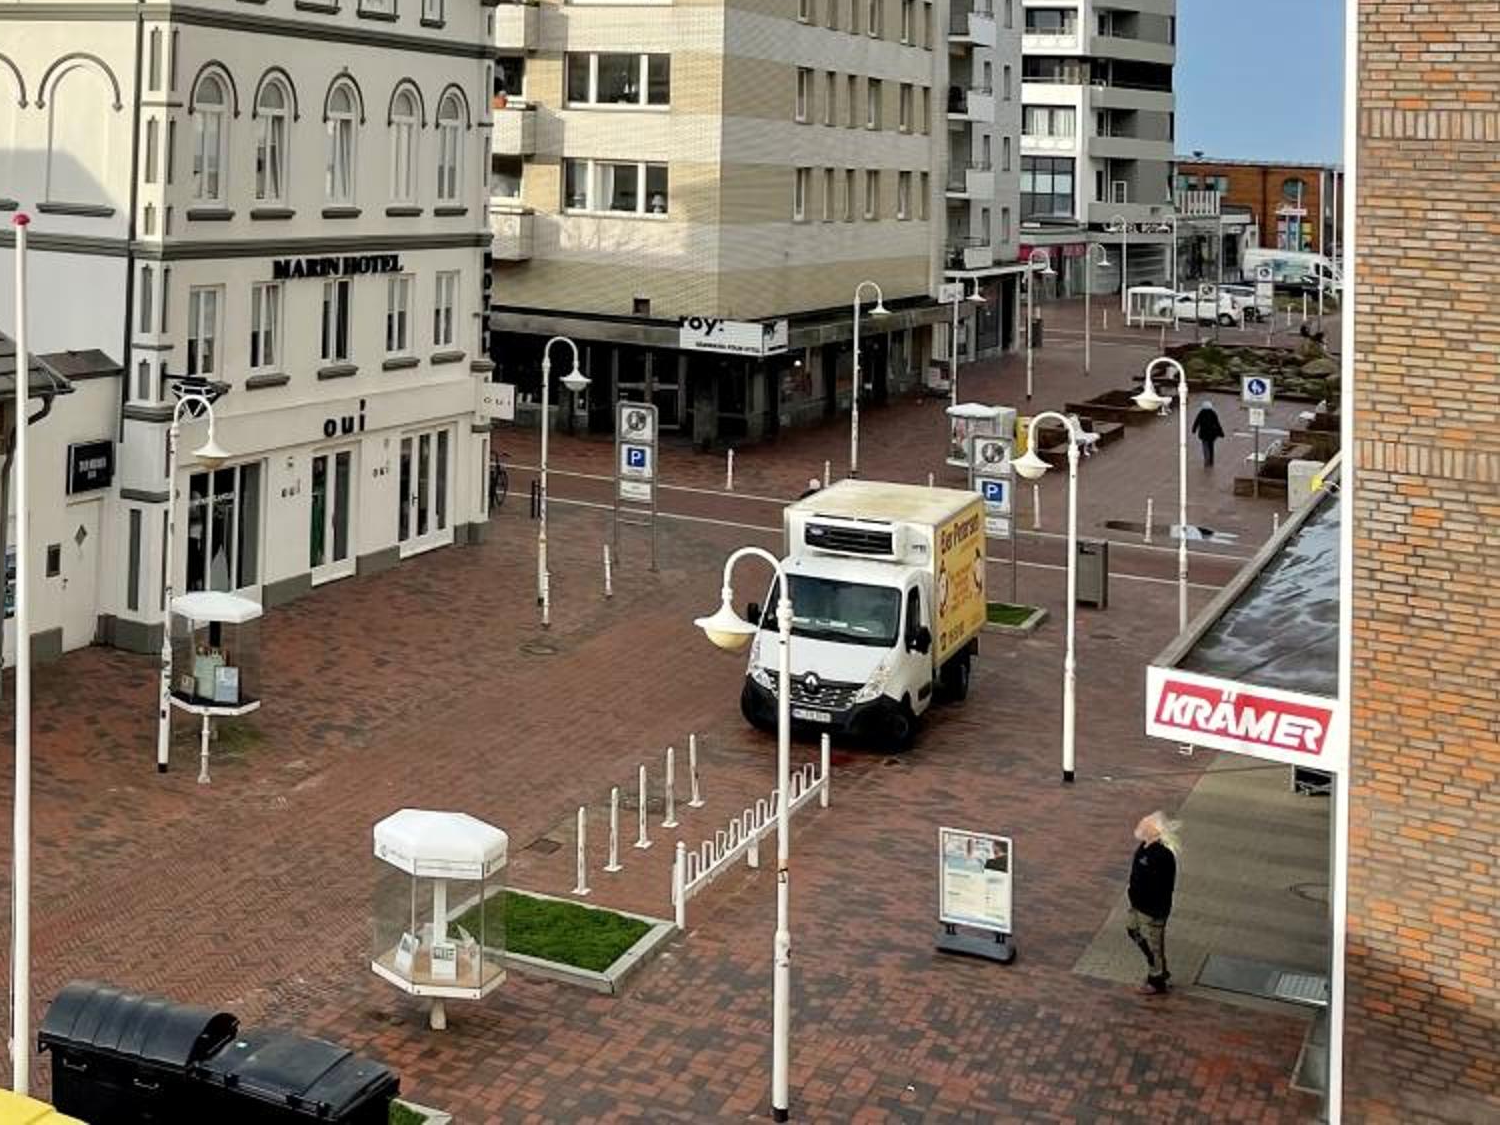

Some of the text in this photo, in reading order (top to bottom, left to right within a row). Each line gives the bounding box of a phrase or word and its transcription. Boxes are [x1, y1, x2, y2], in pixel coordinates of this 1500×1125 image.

[273, 254, 404, 279] MARIN HOTEL
[323, 398, 366, 438] oui
[631, 451, 641, 466] P
[987, 483, 999, 499] P
[1160, 690, 1323, 751] KRÄMER
